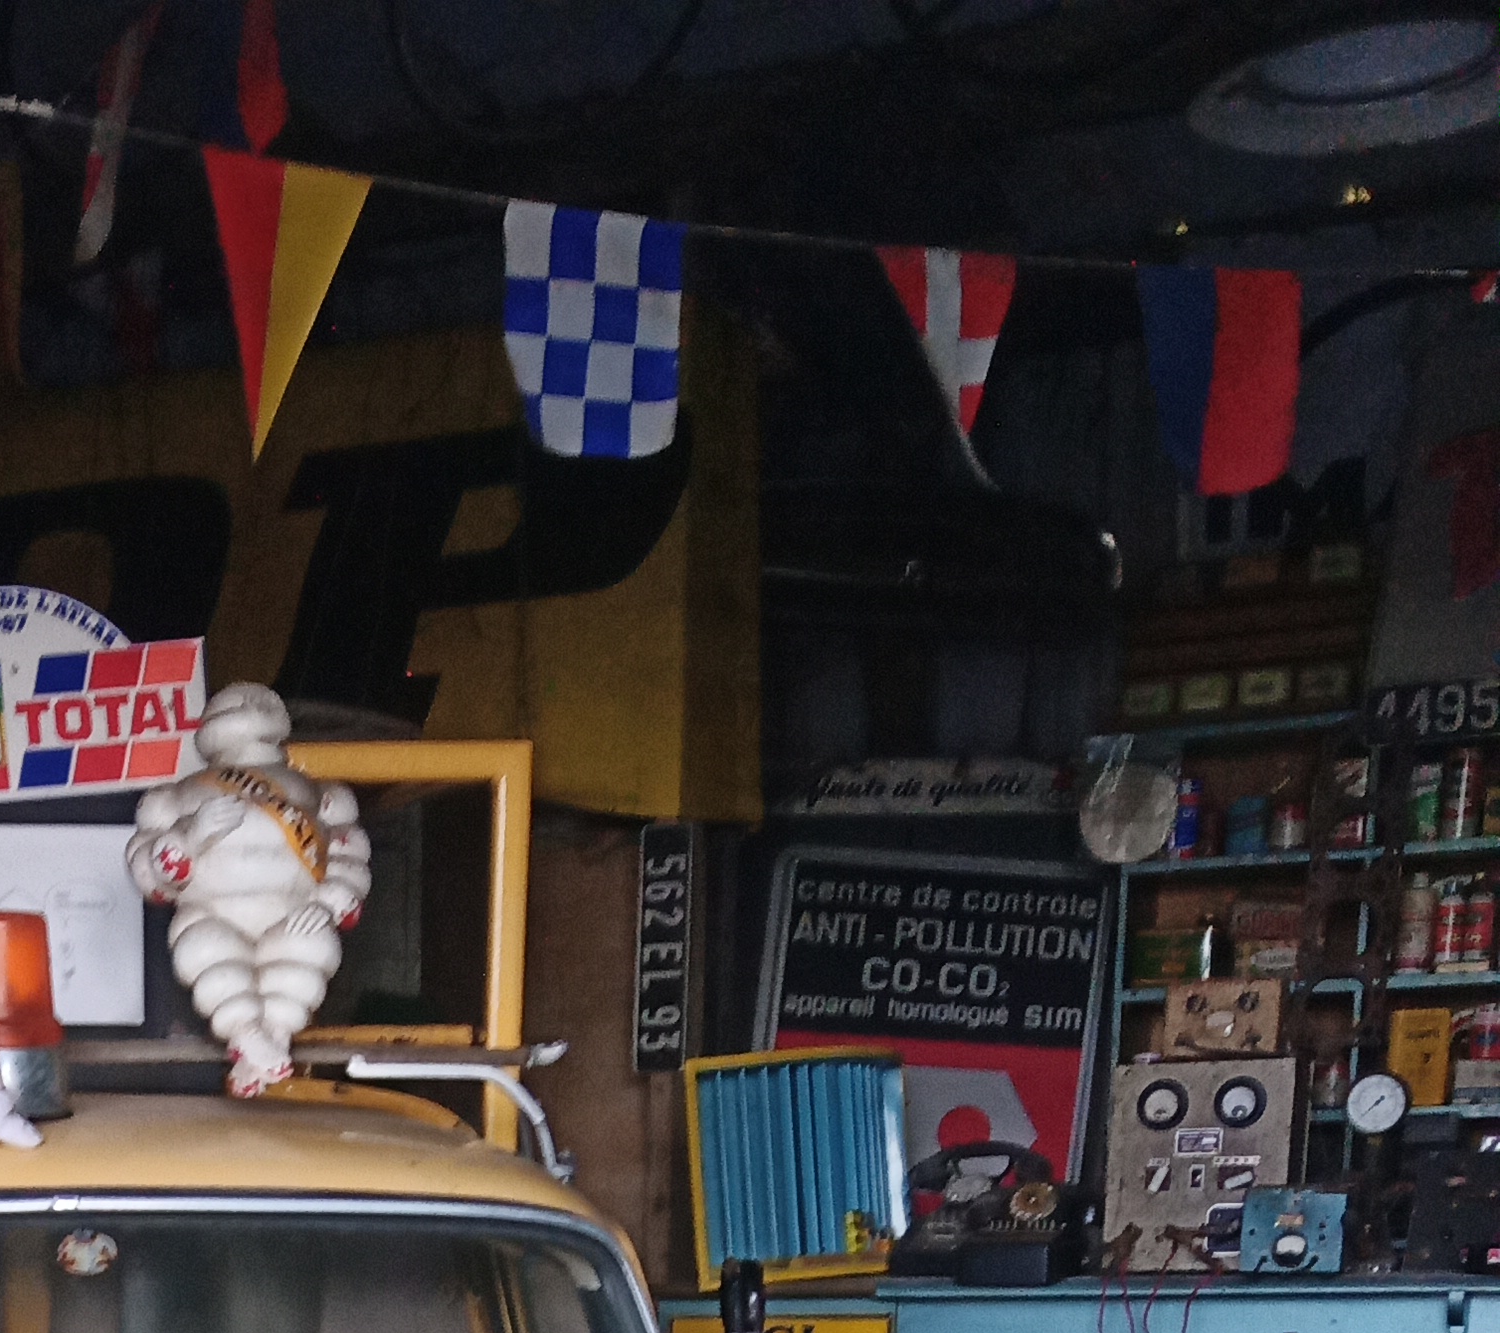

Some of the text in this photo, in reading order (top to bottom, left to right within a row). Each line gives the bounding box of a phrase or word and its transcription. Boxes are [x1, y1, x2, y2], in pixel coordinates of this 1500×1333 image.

[0, 585, 30, 610] DE
[15, 687, 203, 747] TOTAL
[644, 852, 688, 929] 562
[798, 879, 902, 907] centre
[913, 883, 952, 911] de
[784, 994, 876, 1020] appareil
[638, 1004, 682, 1052] 93
